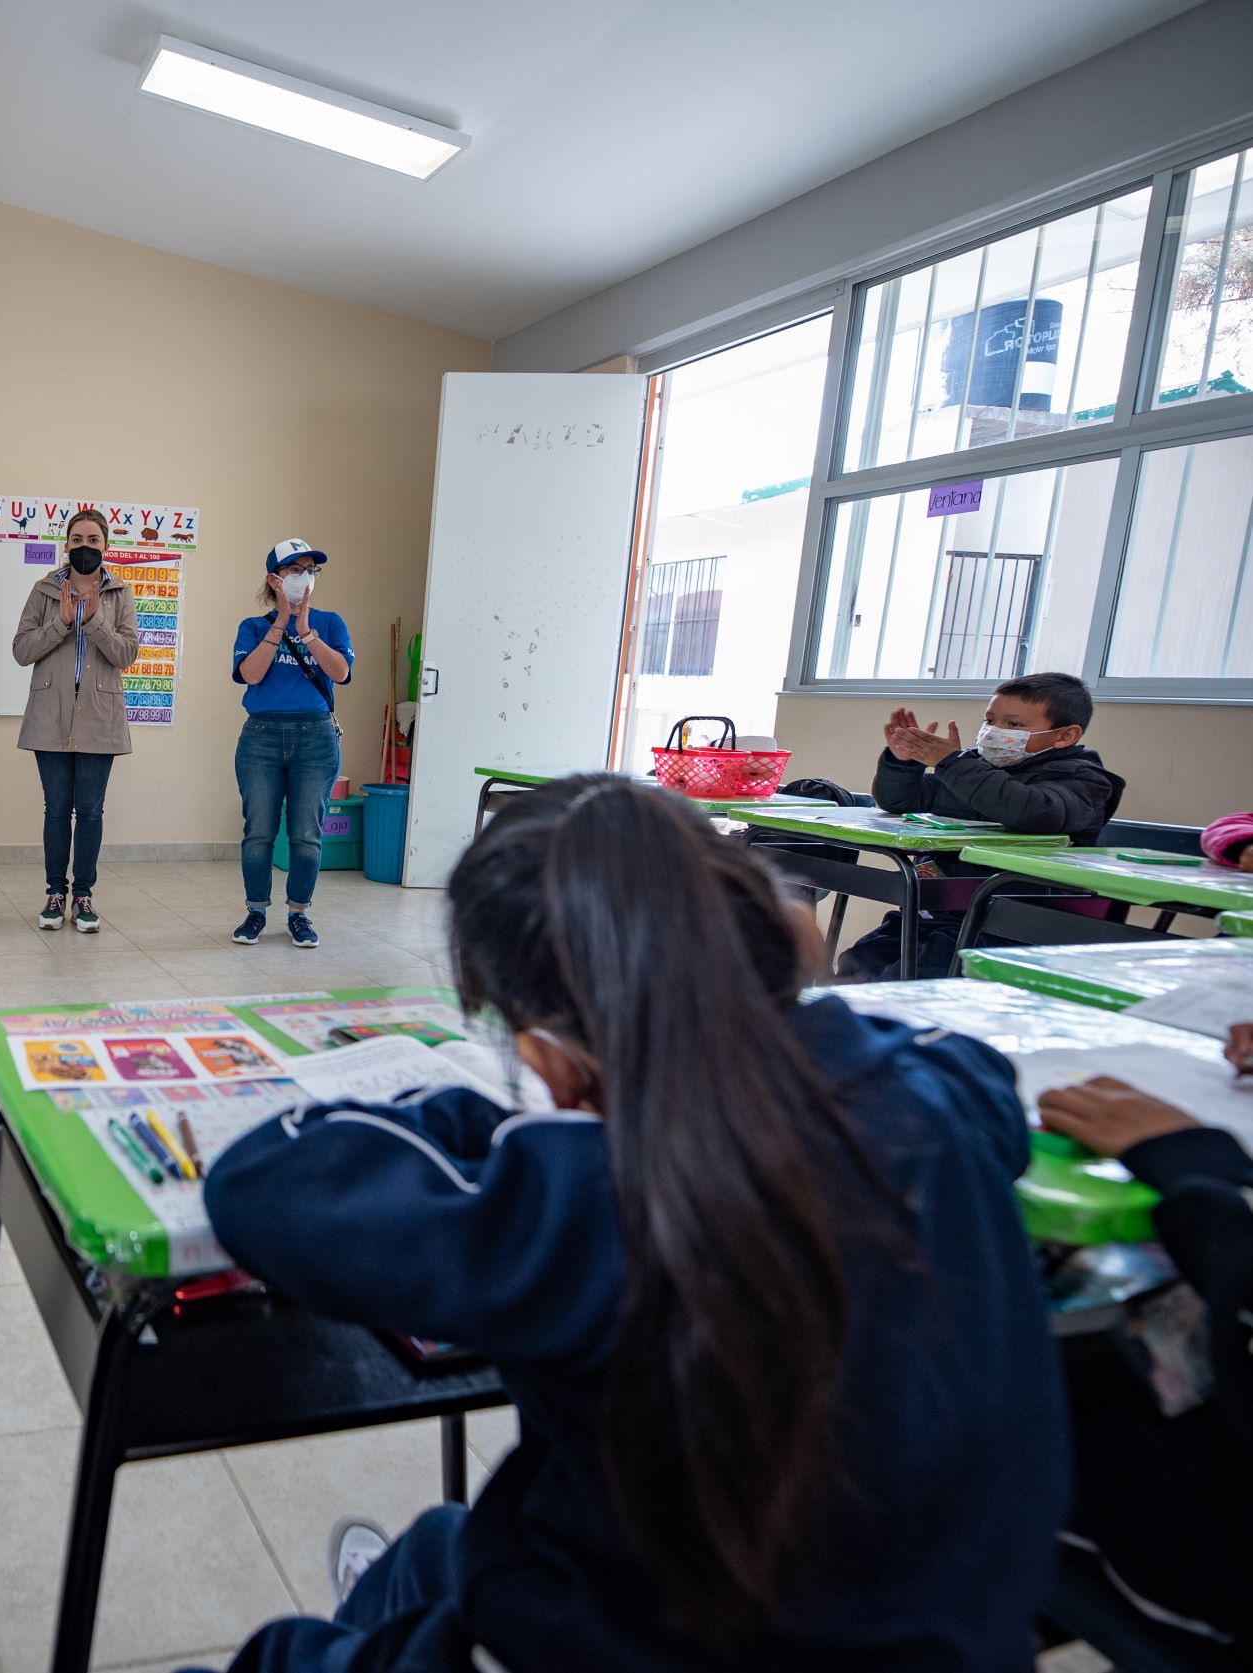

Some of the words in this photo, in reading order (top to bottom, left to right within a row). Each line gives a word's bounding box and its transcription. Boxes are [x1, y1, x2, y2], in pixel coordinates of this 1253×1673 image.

[12, 502, 36, 518] Uu
[44, 504, 70, 520] Vv
[109, 508, 133, 526] Xx
[141, 510, 164, 530] Yy
[174, 512, 194, 530] Zz
[124, 567, 132, 579] 6
[136, 567, 144, 579] 7
[148, 568, 155, 580] 8
[160, 569, 166, 581] 9
[134, 585, 144, 595] 17
[146, 585, 156, 596] 18
[158, 586, 167, 597] 19
[168, 586, 178, 597] 20
[144, 600, 154, 612] 28
[156, 601, 166, 613] 29
[167, 602, 177, 613] 30
[144, 616, 154, 628] 38
[155, 618, 166, 628] 39
[166, 618, 176, 629] 40
[143, 632, 154, 644] 48
[154, 633, 165, 644] 49
[166, 634, 176, 644] 50
[142, 664, 152, 674] 68
[164, 665, 174, 675] 70
[130, 679, 140, 690] 77
[141, 680, 151, 690] 78
[152, 680, 162, 690] 79
[163, 680, 172, 690] 80
[129, 694, 138, 704] 87
[162, 695, 172, 705] 90
[128, 710, 138, 720] 97
[139, 710, 148, 720] 98
[151, 710, 160, 720] 99
[162, 710, 171, 721] 100
